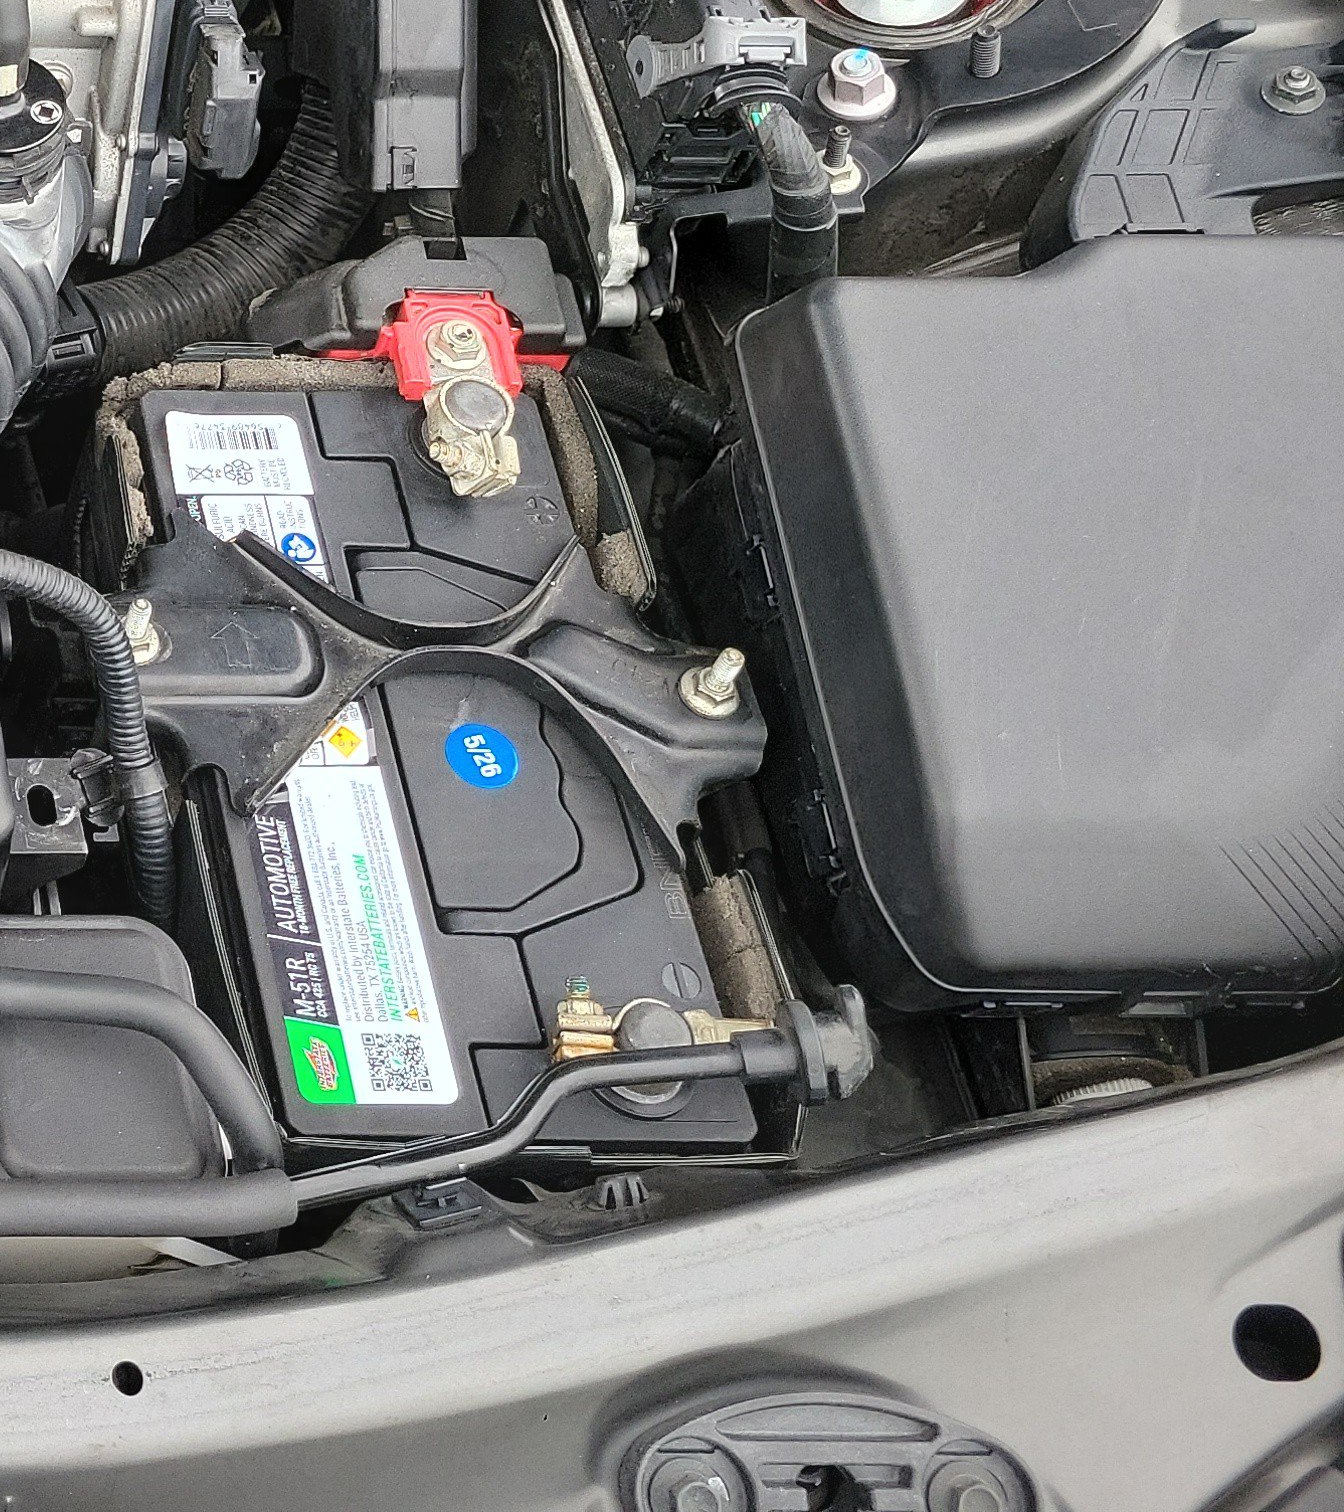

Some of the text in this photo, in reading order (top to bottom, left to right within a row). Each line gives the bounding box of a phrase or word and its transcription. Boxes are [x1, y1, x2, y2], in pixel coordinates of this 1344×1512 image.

[463, 732, 503, 780] 5/26
[253, 815, 298, 932] AUTOMOTIVE
[275, 818, 310, 934] 18-MONTH FREE REPLACEMENT
[340, 907, 359, 952] Interstate
[351, 854, 403, 1021] INTERSTATEBATTERIES.COM
[355, 920, 369, 940] USA
[351, 956, 363, 965] by
[360, 943, 377, 970] 75254
[284, 956, 316, 1016] M-51R
[310, 981, 324, 998] 425
[353, 968, 375, 1021] Distributed
[367, 974, 380, 986] TX
